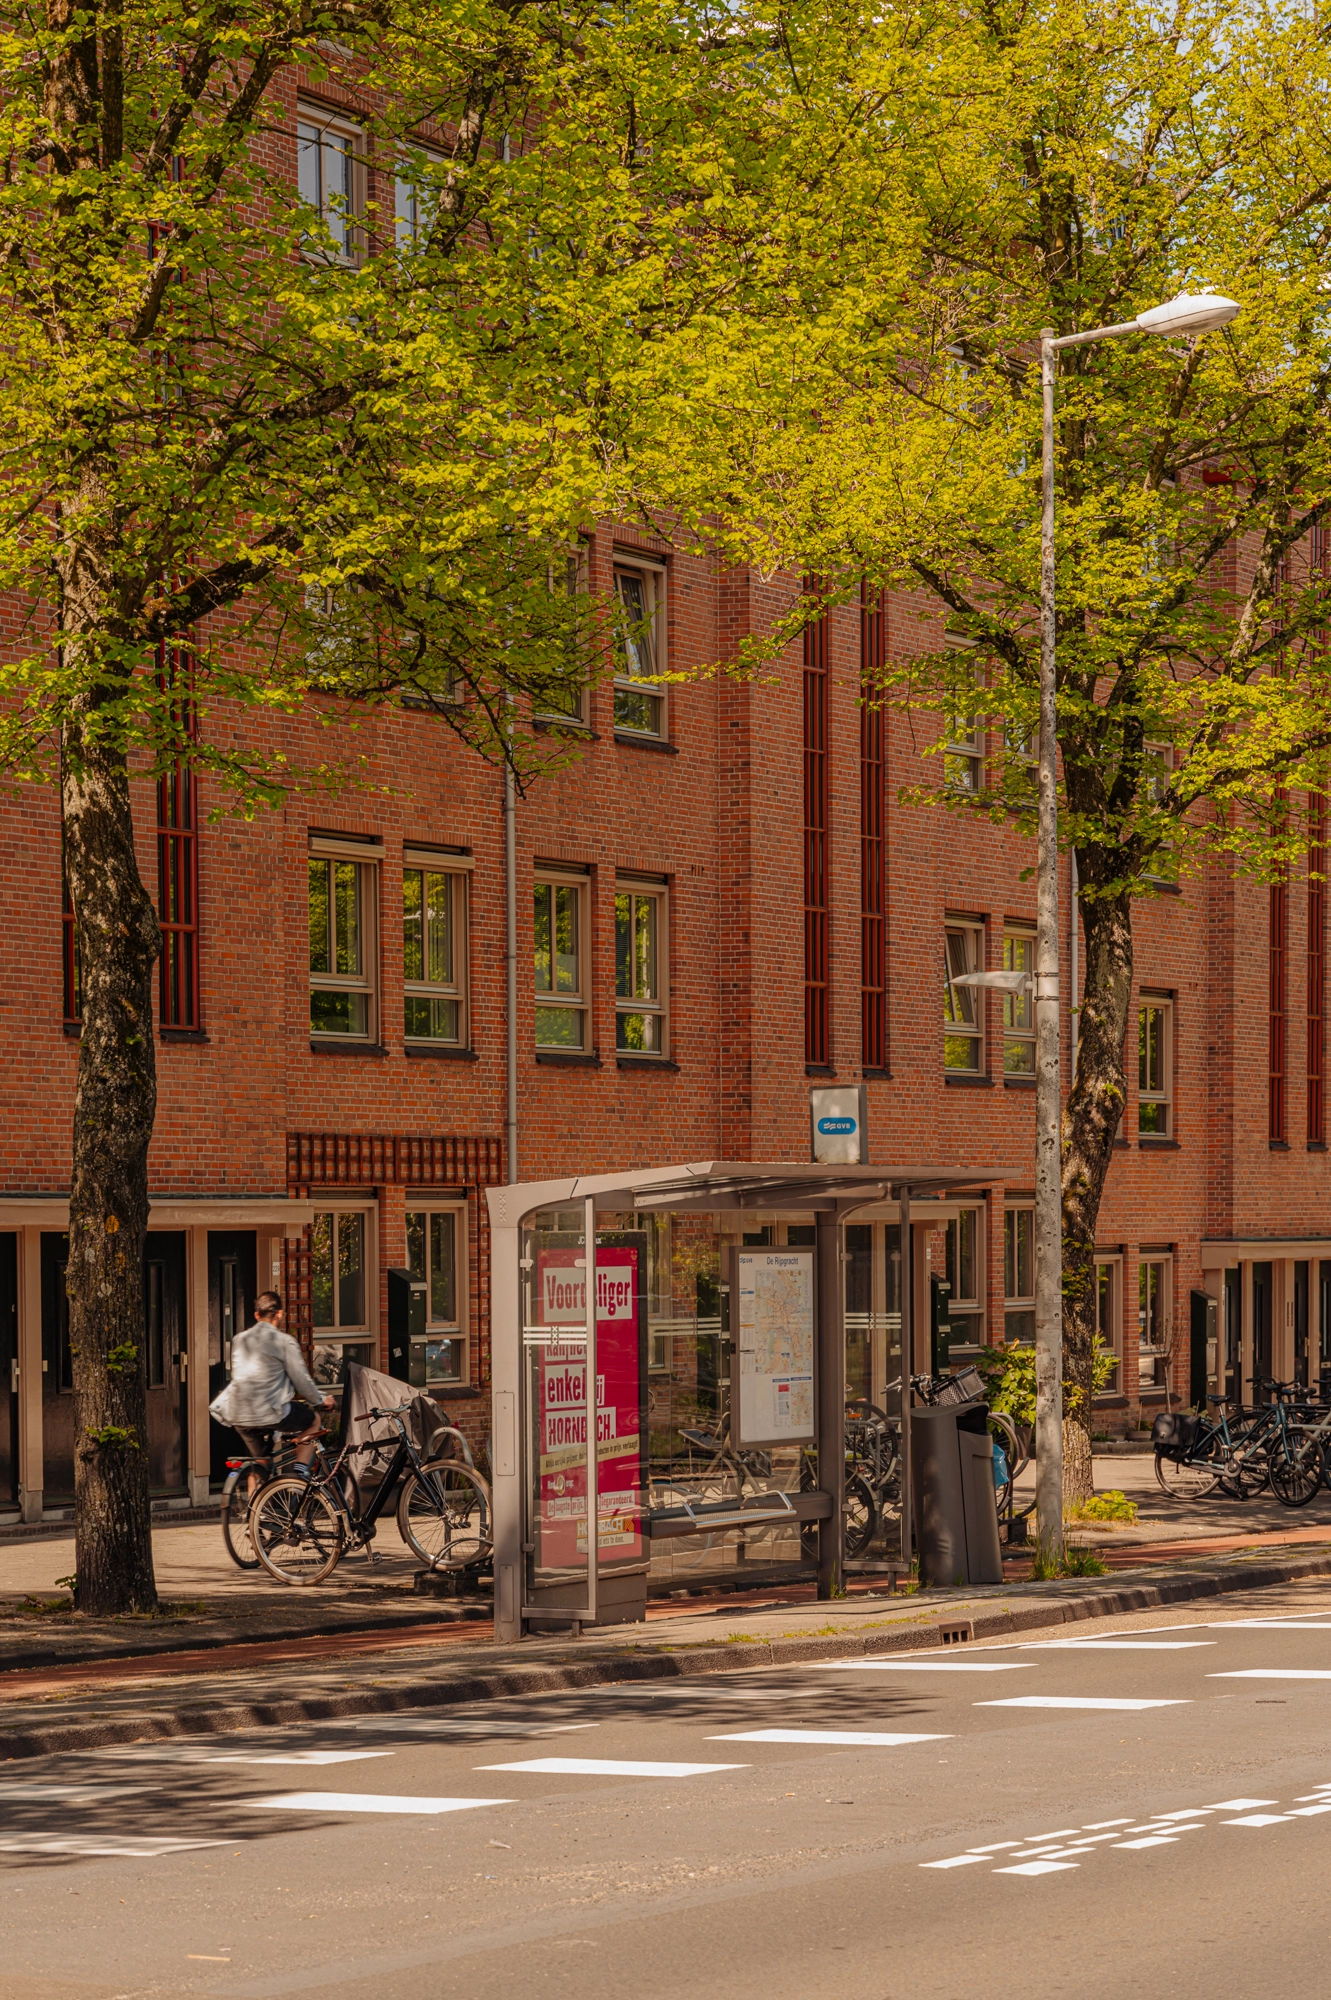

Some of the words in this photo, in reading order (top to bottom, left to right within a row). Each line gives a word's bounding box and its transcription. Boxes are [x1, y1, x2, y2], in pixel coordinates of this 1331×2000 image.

[767, 1256, 773, 1265] De
[775, 1256, 799, 1267] Rijpgracht
[546, 1273, 630, 1316] Voordliger
[549, 1414, 615, 1446] HORNBCH.
[548, 1502, 554, 1512] De
[577, 1518, 623, 1537] HONBACH
